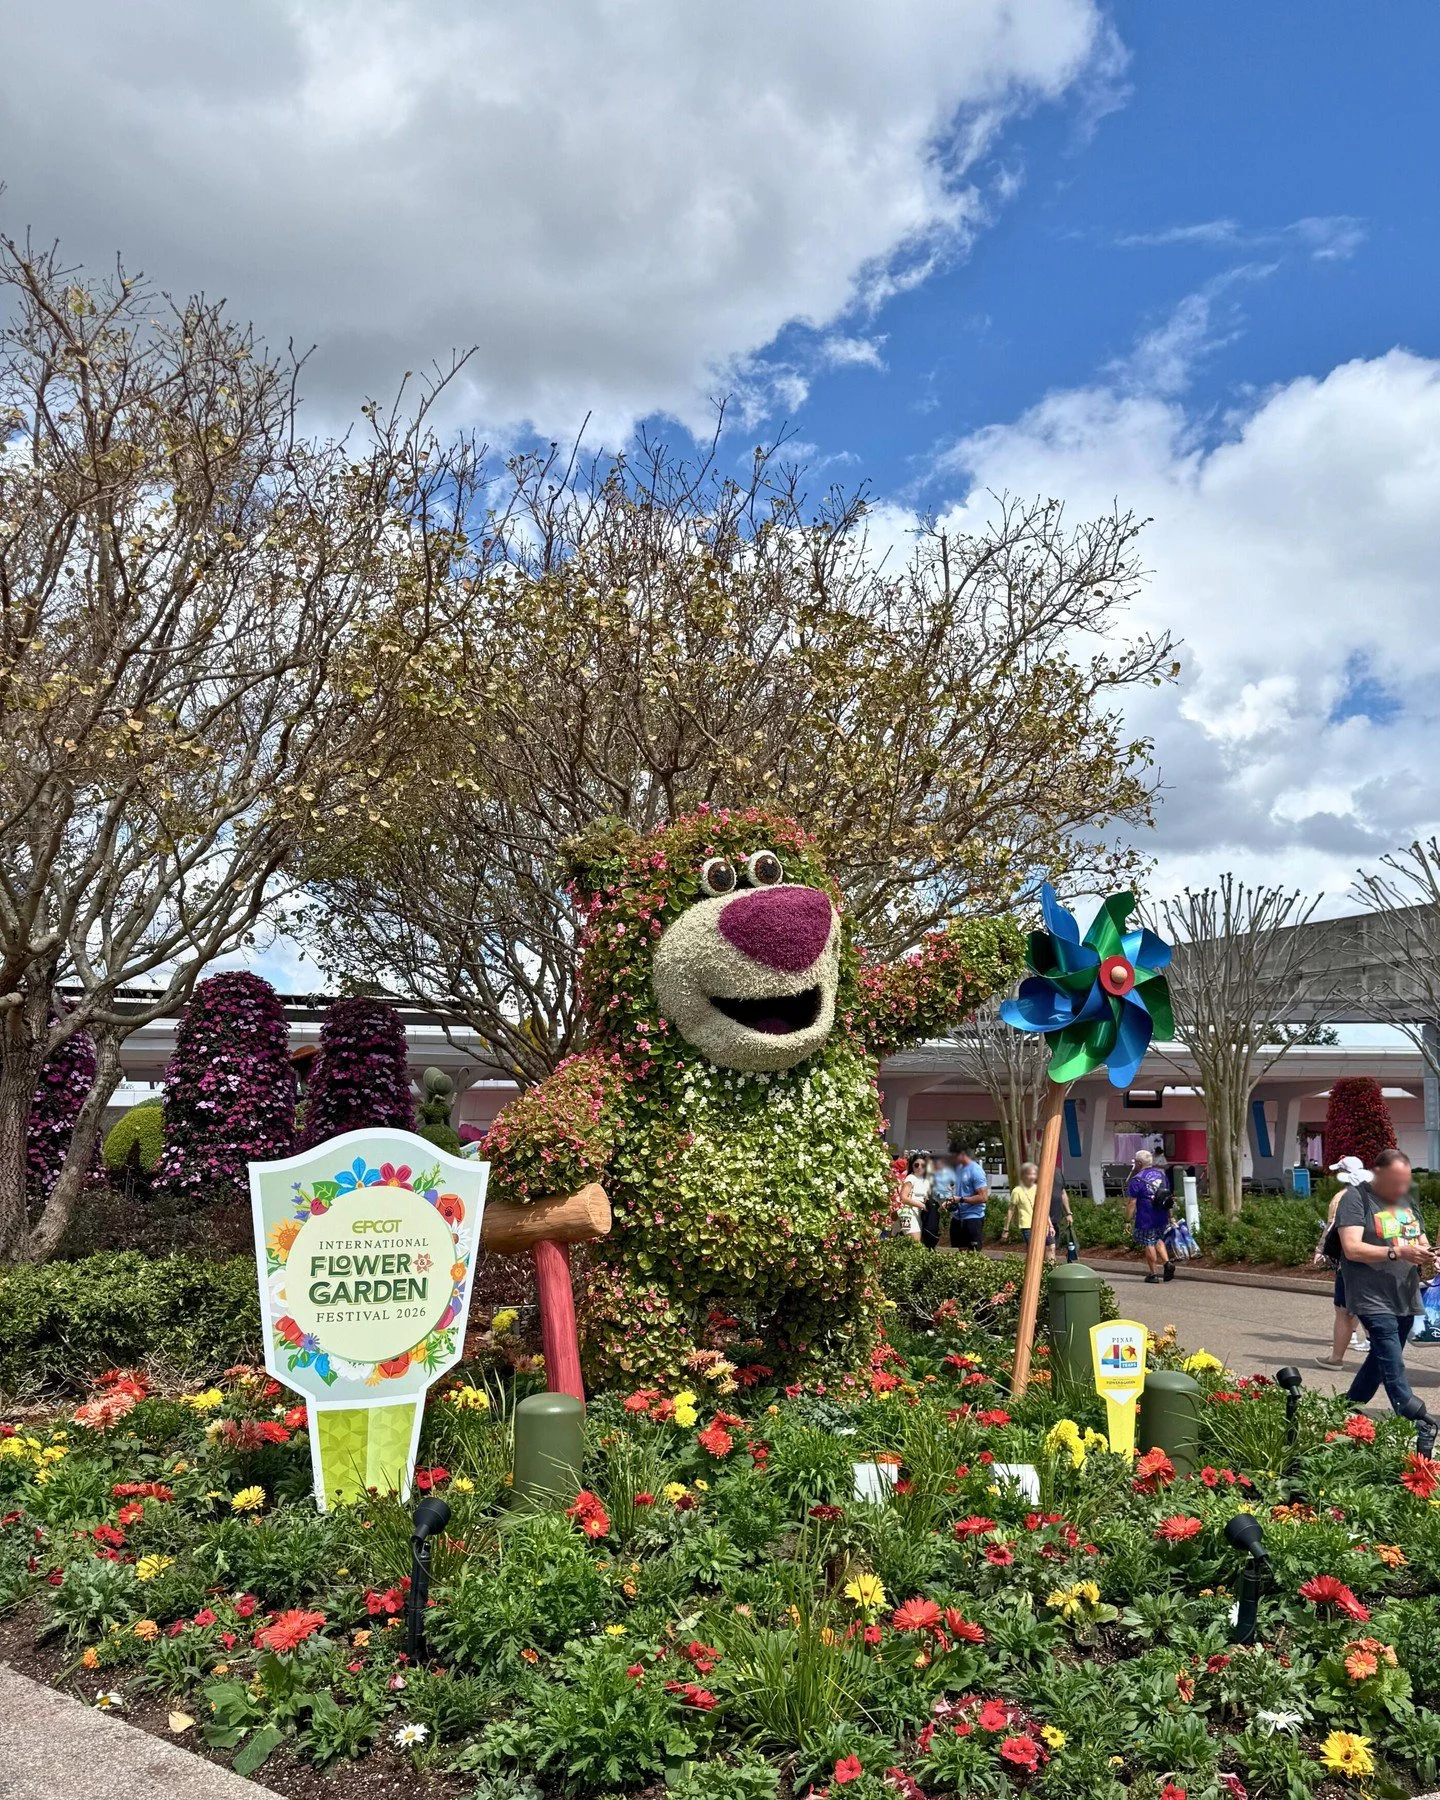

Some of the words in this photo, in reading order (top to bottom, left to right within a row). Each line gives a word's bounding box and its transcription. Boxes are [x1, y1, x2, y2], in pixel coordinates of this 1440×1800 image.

[352, 1219, 402, 1234] EPCOT
[319, 1238, 429, 1250] INTERNATIONAL
[310, 1253, 412, 1277] FLOWER
[308, 1277, 428, 1307] GARDEN
[316, 1310, 390, 1323] FESTIVAL
[396, 1307, 426, 1319] 2026
